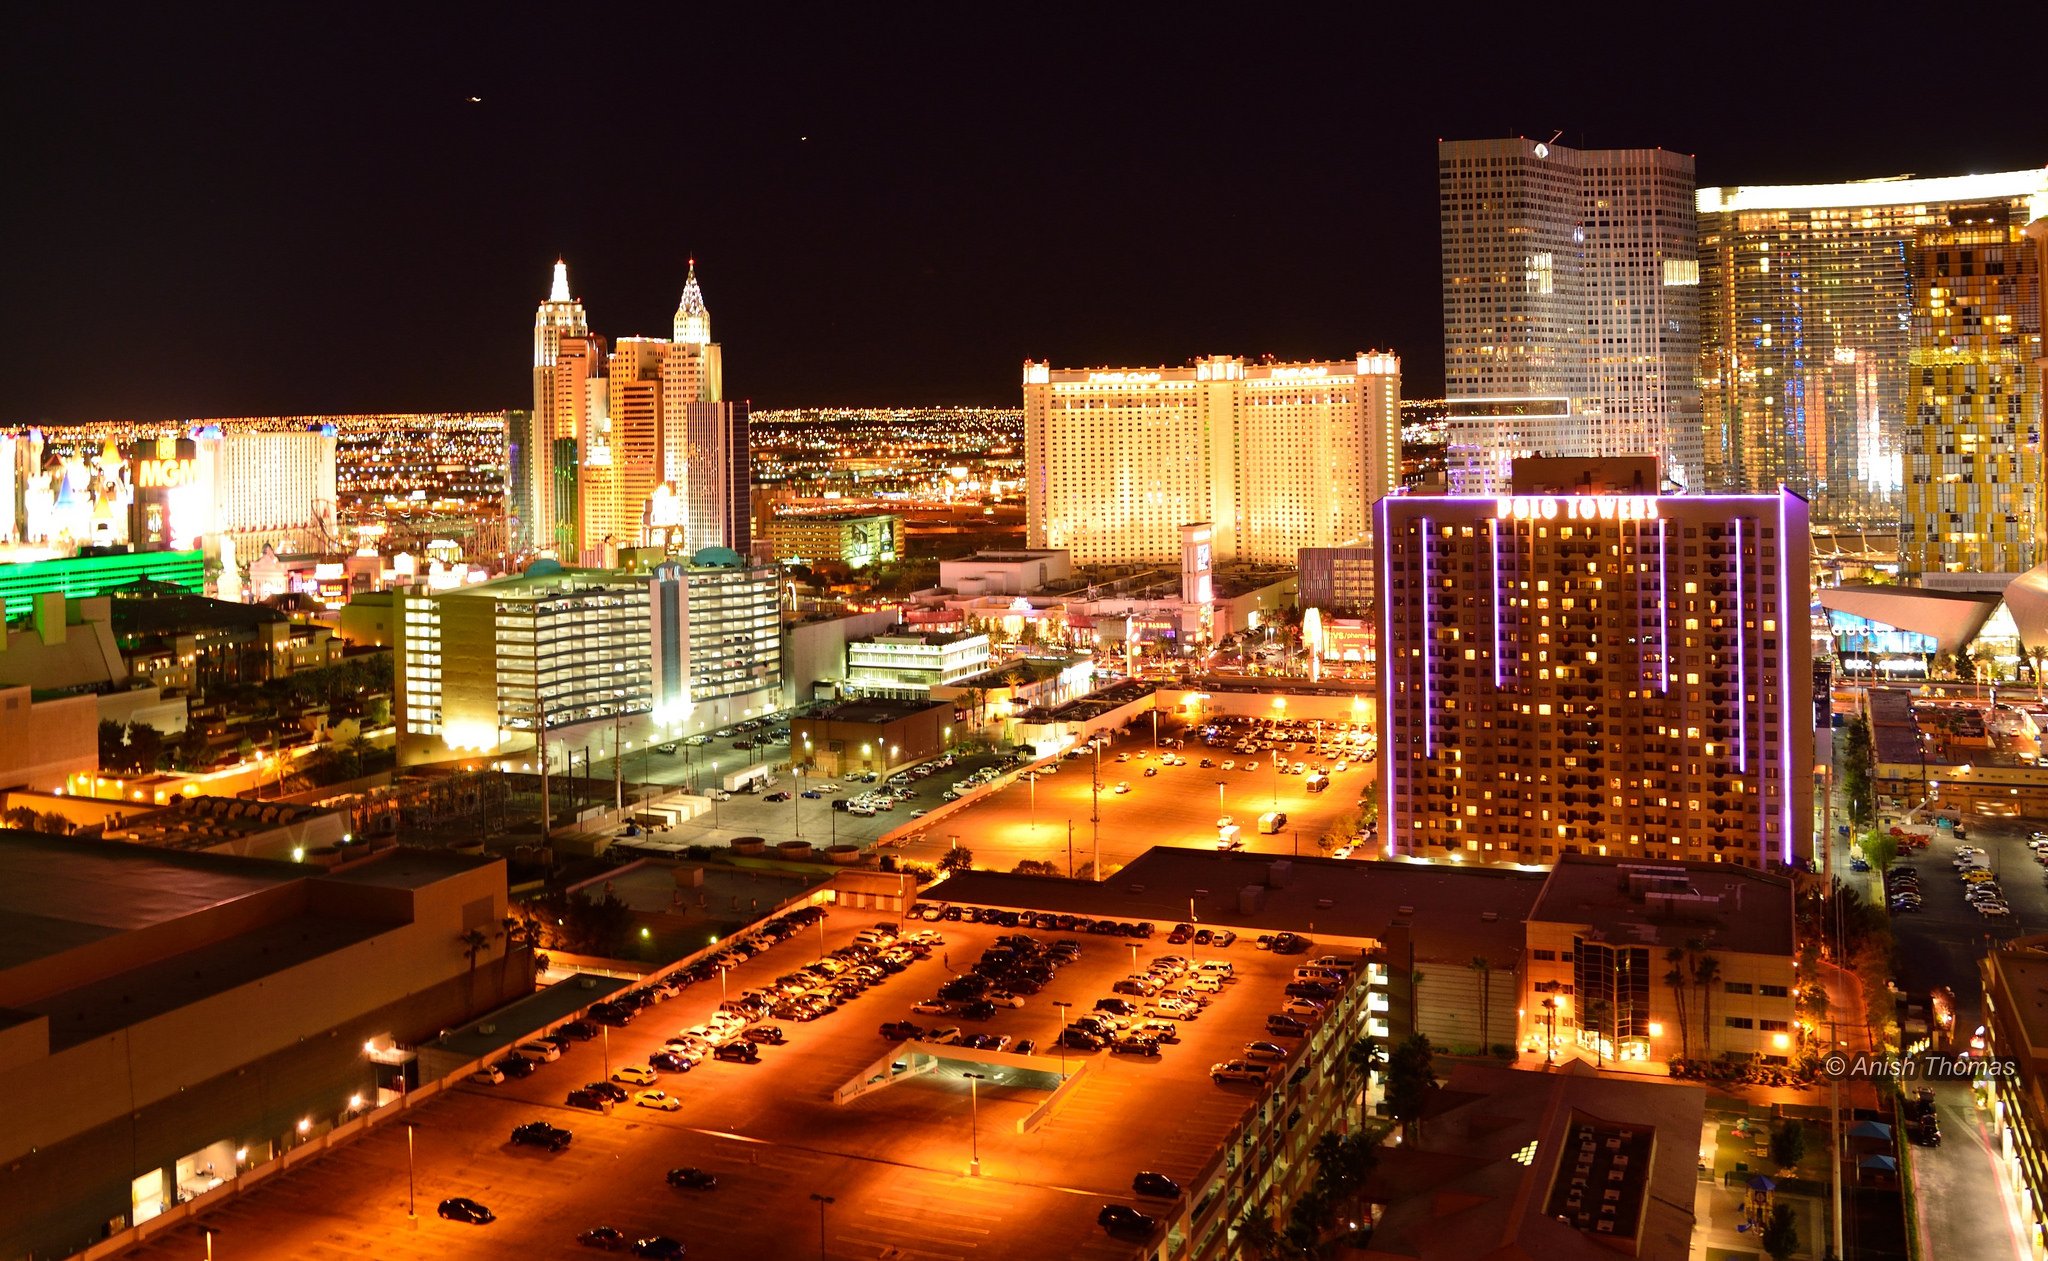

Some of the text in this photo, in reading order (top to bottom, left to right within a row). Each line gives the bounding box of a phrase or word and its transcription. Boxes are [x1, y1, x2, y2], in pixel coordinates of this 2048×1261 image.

[139, 459, 199, 487] MGM
[1497, 497, 1658, 520] POLO TOWERS
